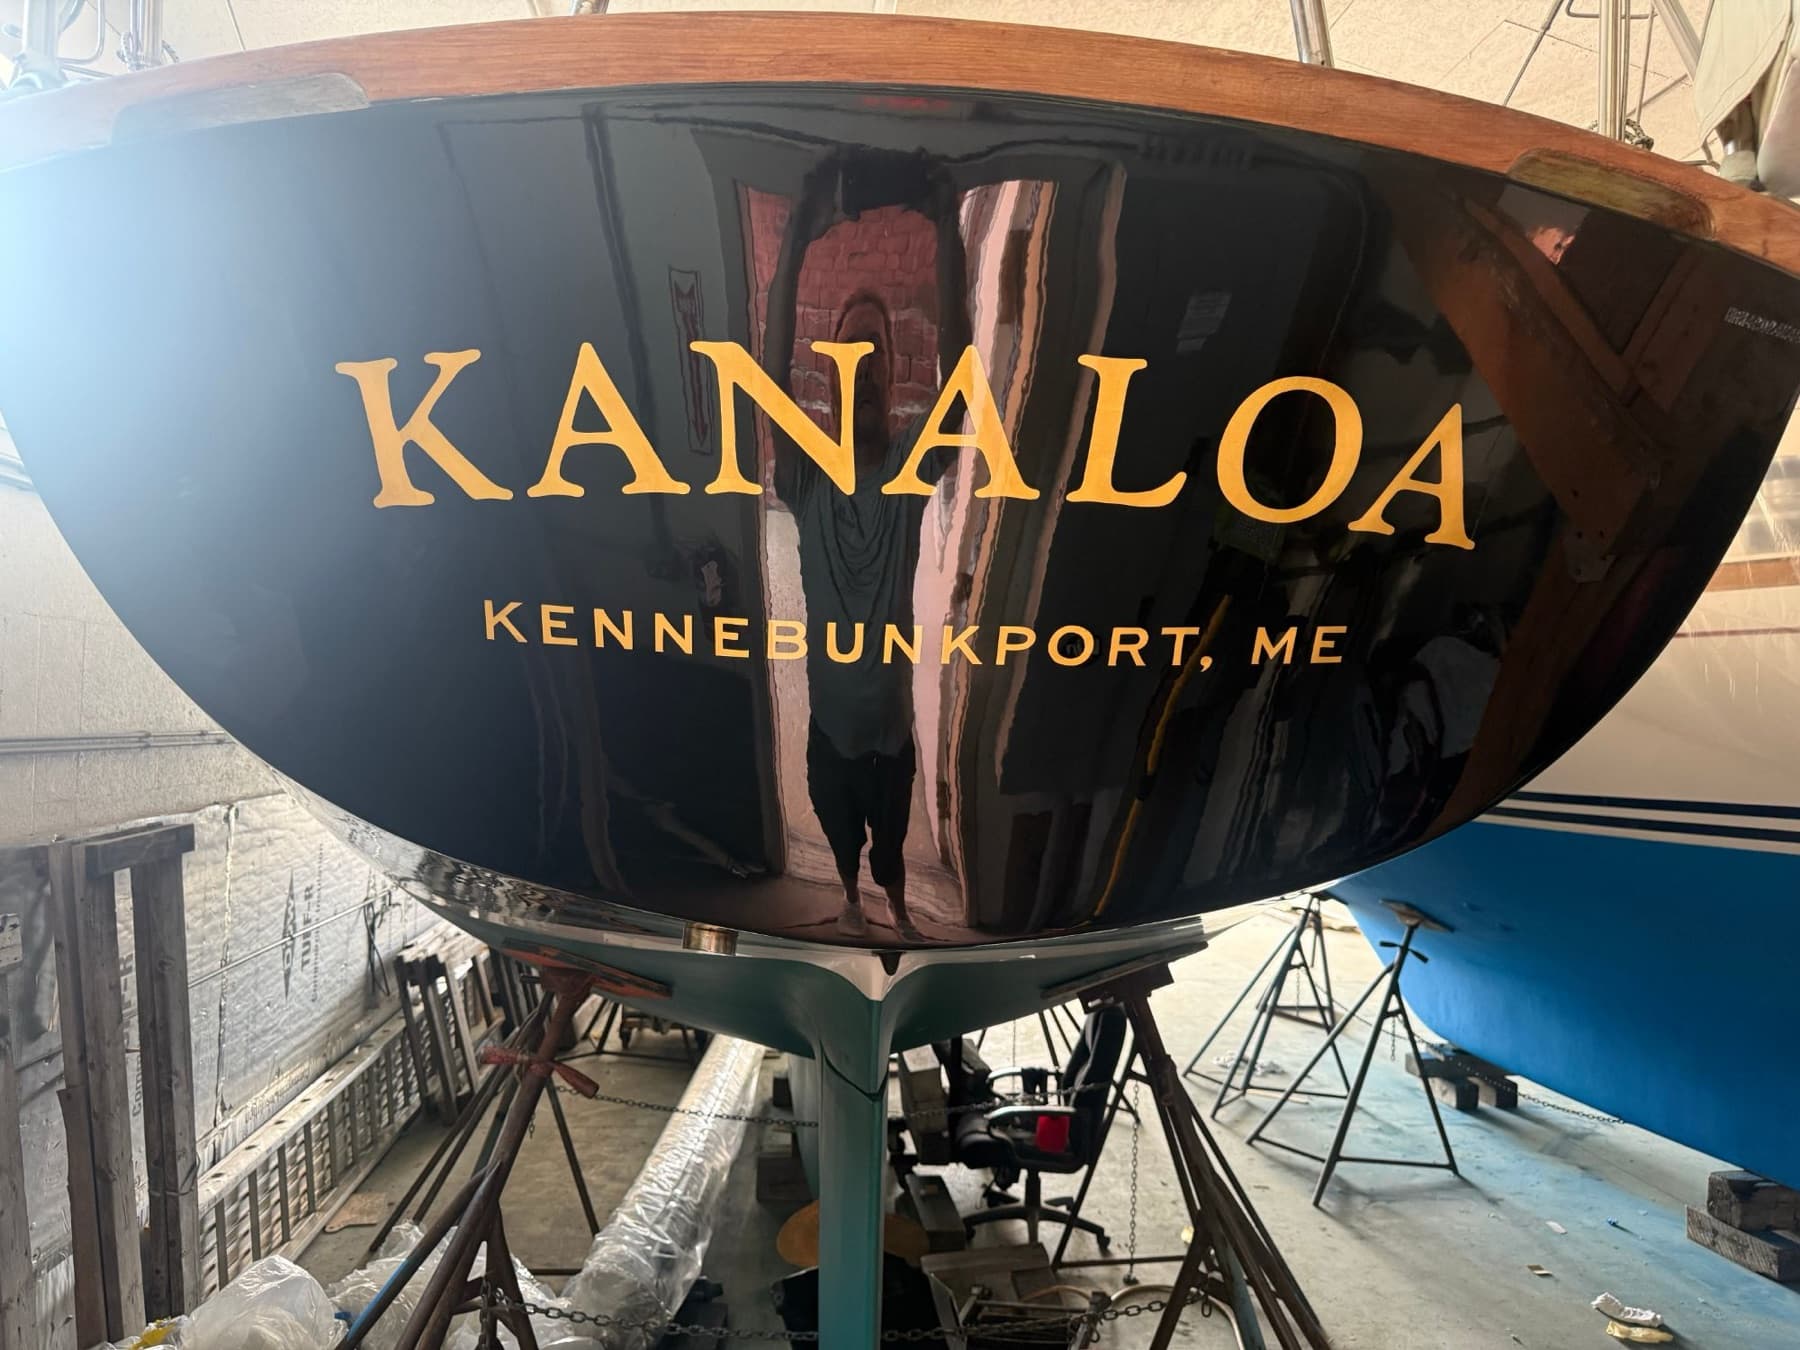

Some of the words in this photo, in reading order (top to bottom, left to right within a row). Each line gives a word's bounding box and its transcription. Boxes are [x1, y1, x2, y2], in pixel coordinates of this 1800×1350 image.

[335, 341, 1475, 550] KANALOA
[483, 599, 1213, 672] KENNEBUNKPORT,
[1251, 626, 1347, 665] ME
